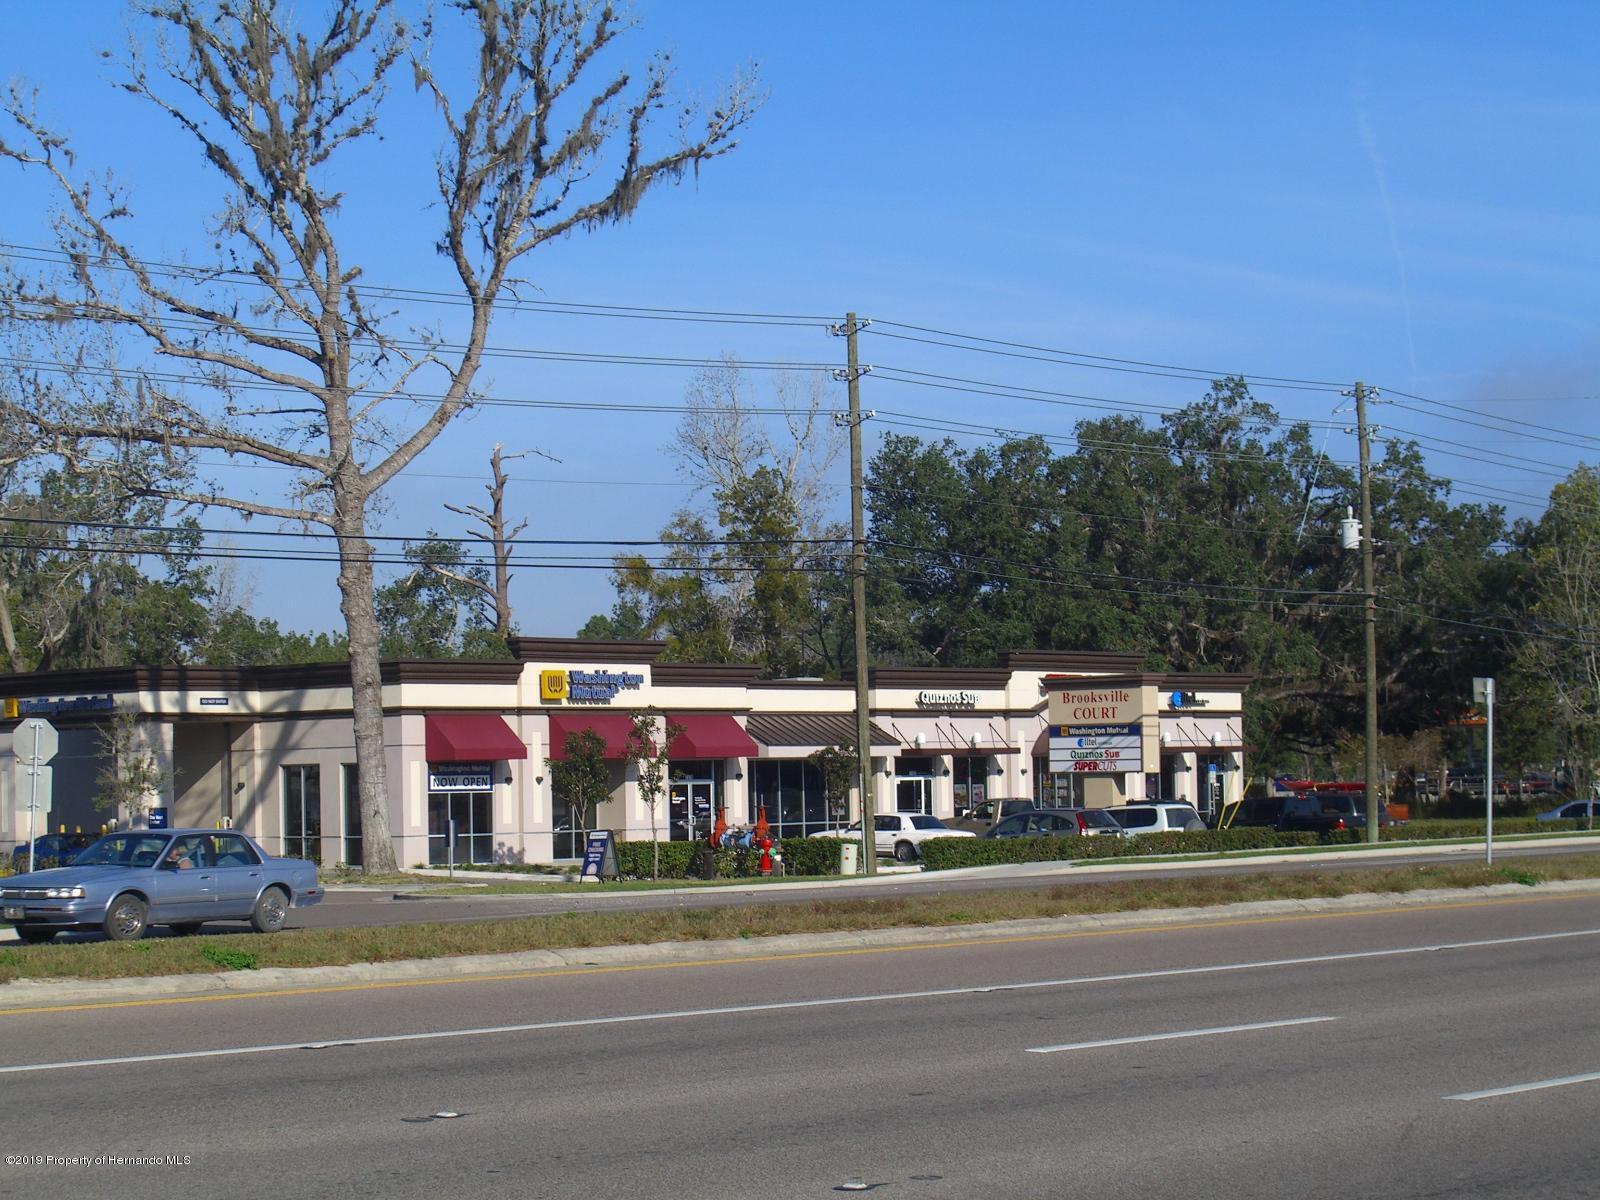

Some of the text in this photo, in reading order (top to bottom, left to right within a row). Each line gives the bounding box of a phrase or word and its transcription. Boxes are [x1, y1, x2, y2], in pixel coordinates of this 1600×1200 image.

[569, 670, 644, 687] Washington
[569, 684, 615, 699] Mutual
[1062, 691, 1129, 704] Brooksville
[1073, 707, 1118, 720] COURT
[1069, 728, 1106, 736] Washington
[1073, 761, 1117, 771] SUPERCUTS
[433, 777, 488, 787] NOW OPEN
